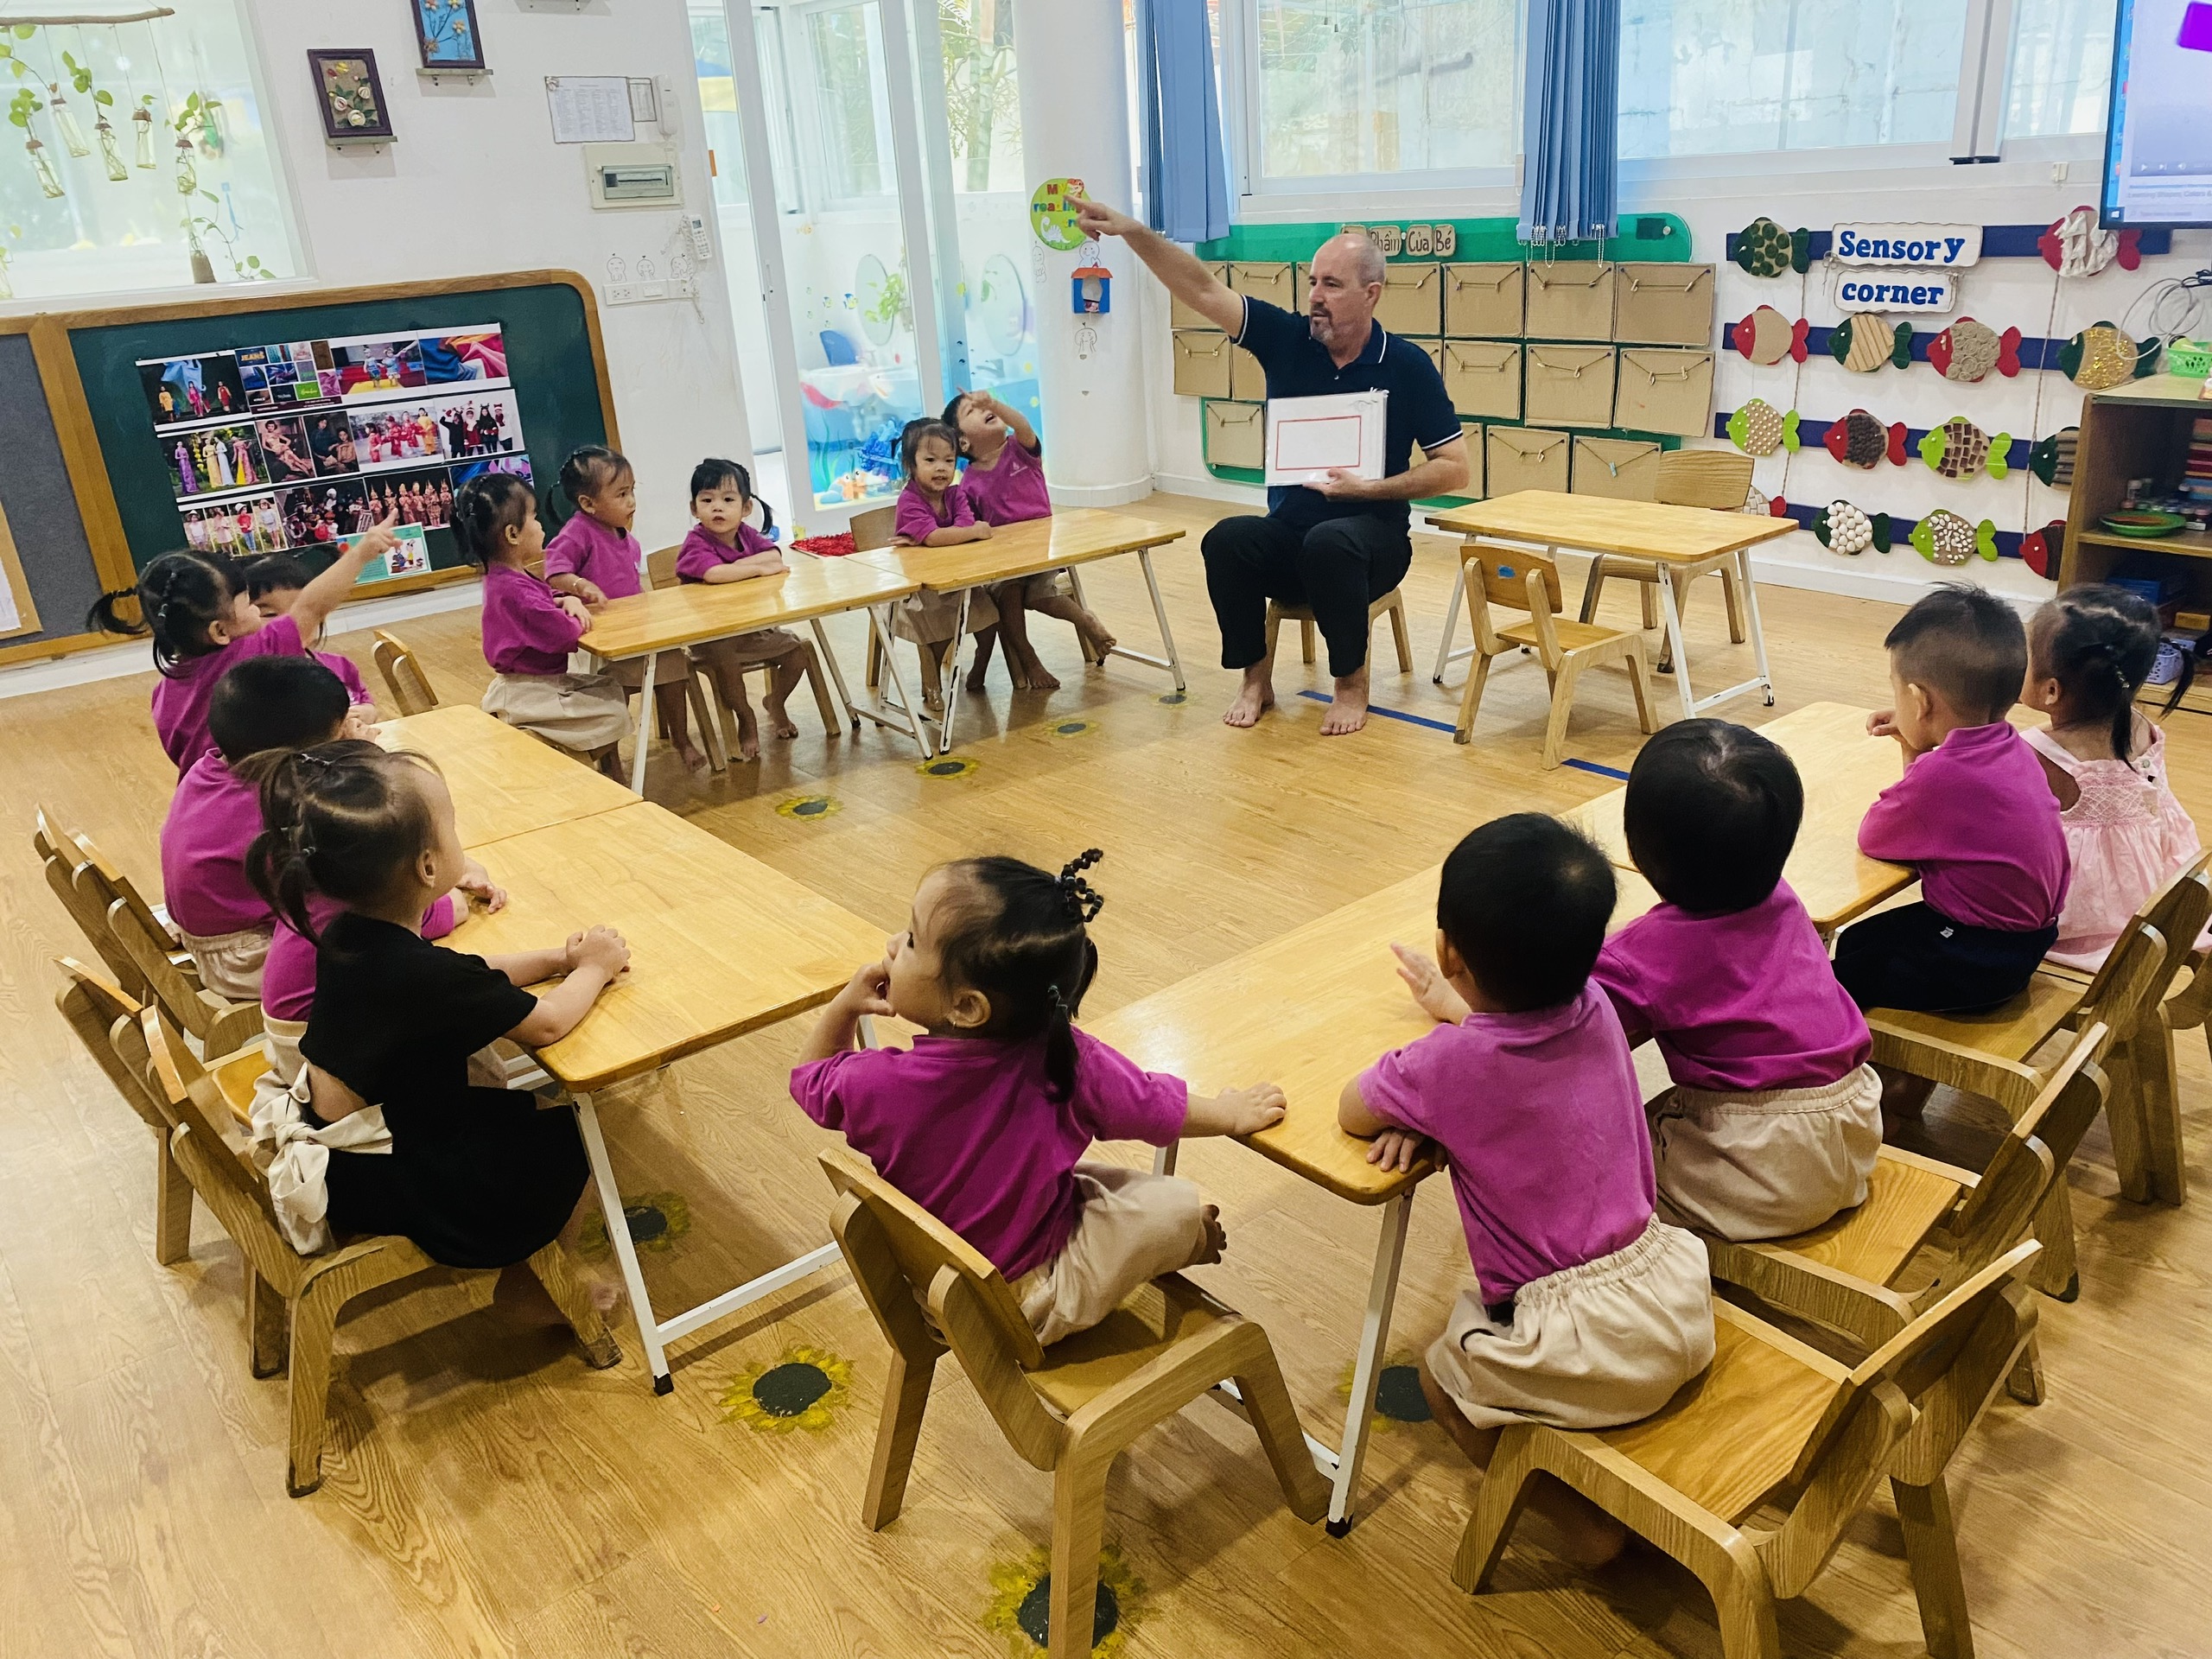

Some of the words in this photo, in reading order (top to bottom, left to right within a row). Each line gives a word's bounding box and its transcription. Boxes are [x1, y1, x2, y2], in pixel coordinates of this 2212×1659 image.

[1408, 231, 1429, 252] Của
[1435, 230, 1452, 252] Bé
[1839, 231, 1966, 263] Sensory
[1841, 283, 1944, 305] corner
[241, 351, 265, 361] JEANS
